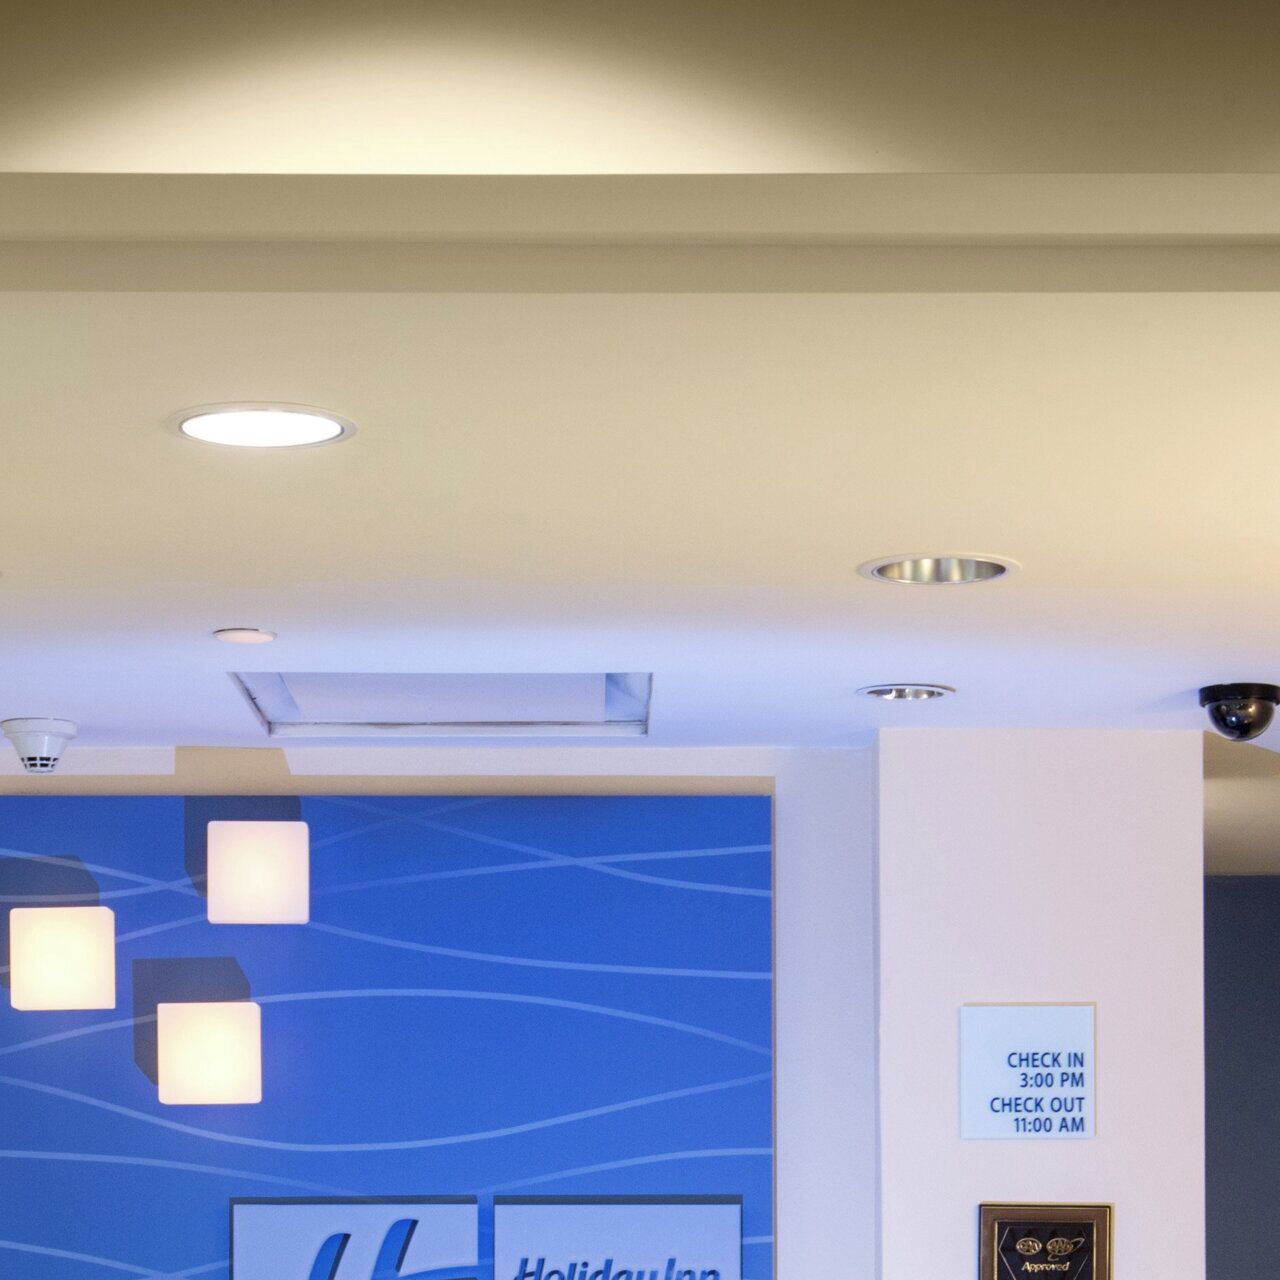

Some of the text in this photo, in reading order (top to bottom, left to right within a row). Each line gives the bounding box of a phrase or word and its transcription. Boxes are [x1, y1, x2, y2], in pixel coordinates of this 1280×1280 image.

[1007, 1052, 1085, 1068] CHECK IN
[1019, 1072, 1085, 1088] 3:00 PM
[990, 1097, 1085, 1113] CHECK OUT
[1014, 1117, 1085, 1132] 11:00 AM
[1021, 1261, 1070, 1272] Approved
